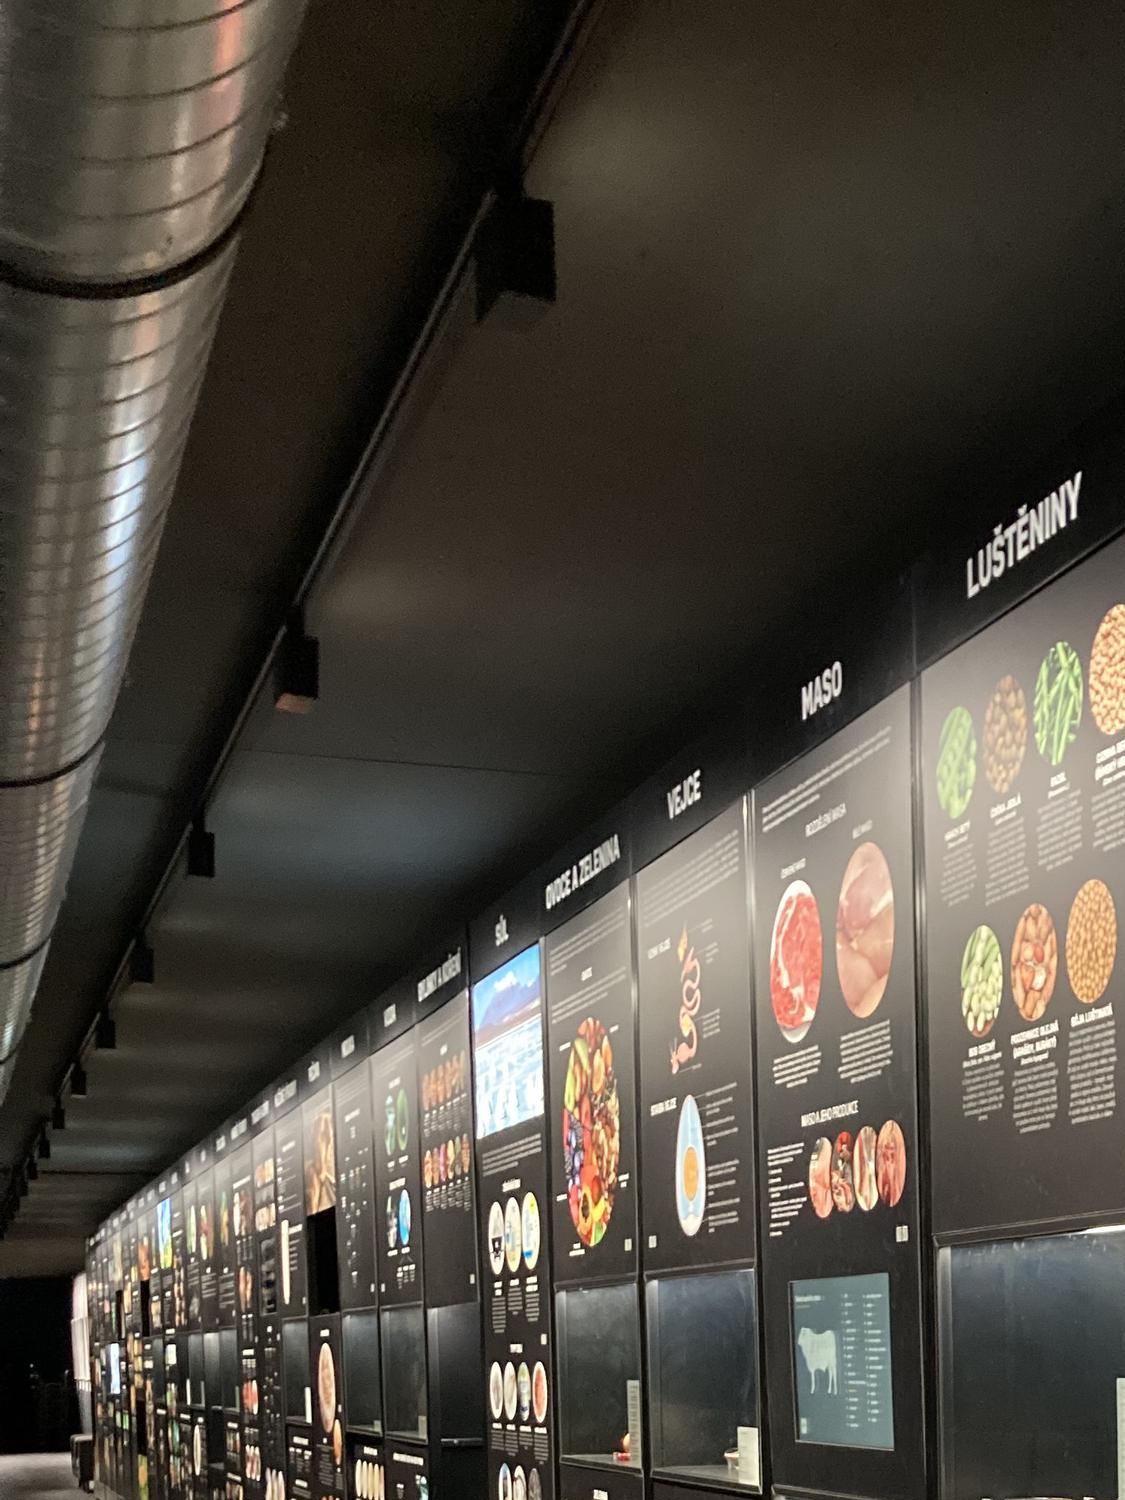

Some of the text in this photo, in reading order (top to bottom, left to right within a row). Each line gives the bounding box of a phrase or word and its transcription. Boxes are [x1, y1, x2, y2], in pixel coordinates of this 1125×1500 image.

[966, 470, 1083, 600] LUŠTĚNINY
[800, 660, 844, 721] MASO
[666, 768, 702, 820] VEJCE
